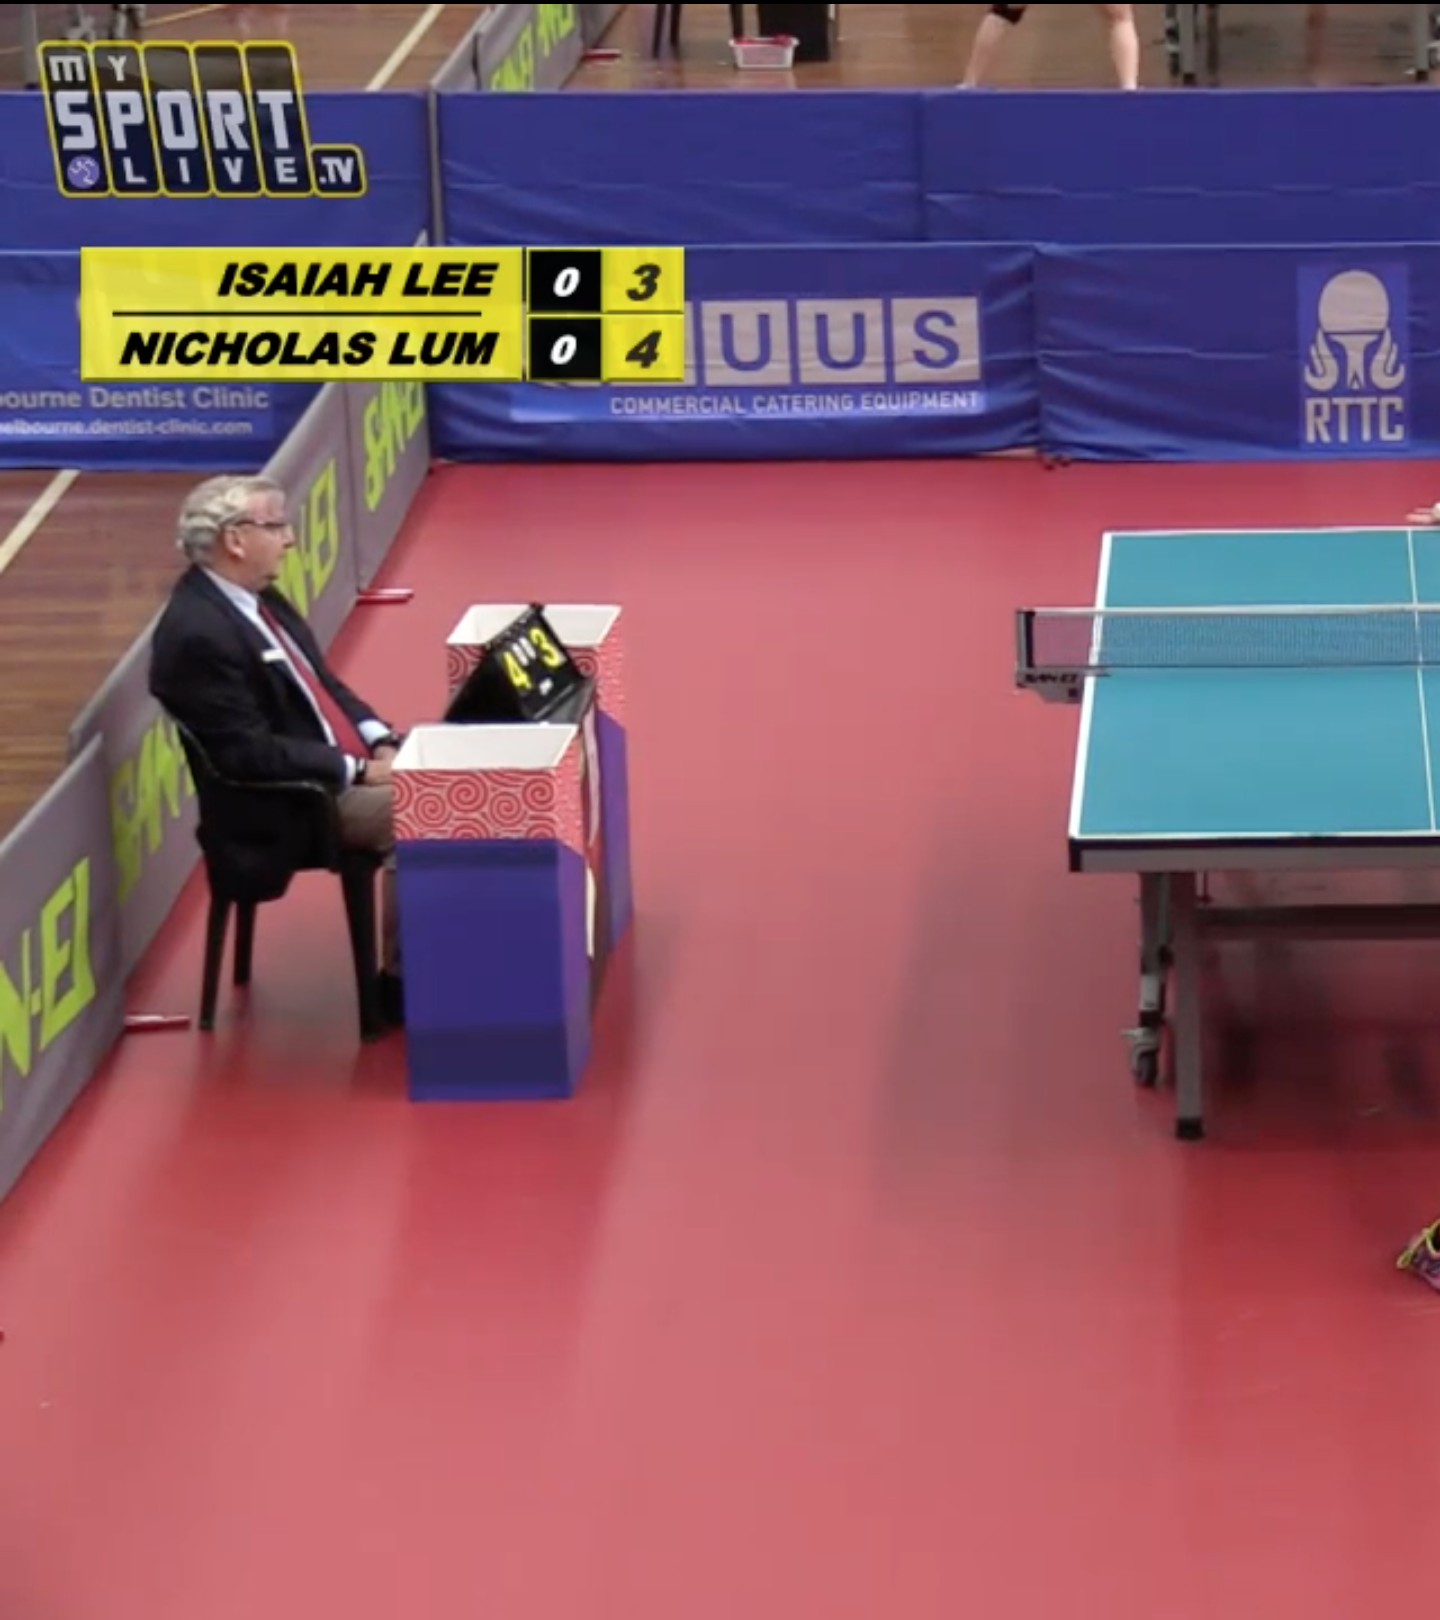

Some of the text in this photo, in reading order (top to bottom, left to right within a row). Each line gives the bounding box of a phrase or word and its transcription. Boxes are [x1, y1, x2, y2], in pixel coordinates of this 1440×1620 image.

[0, 385, 269, 409] ourne Dentist Clinic
[611, 390, 980, 416] COMMERCIAL CATERING EQUIPMENT
[1304, 396, 1405, 446] RTTC
